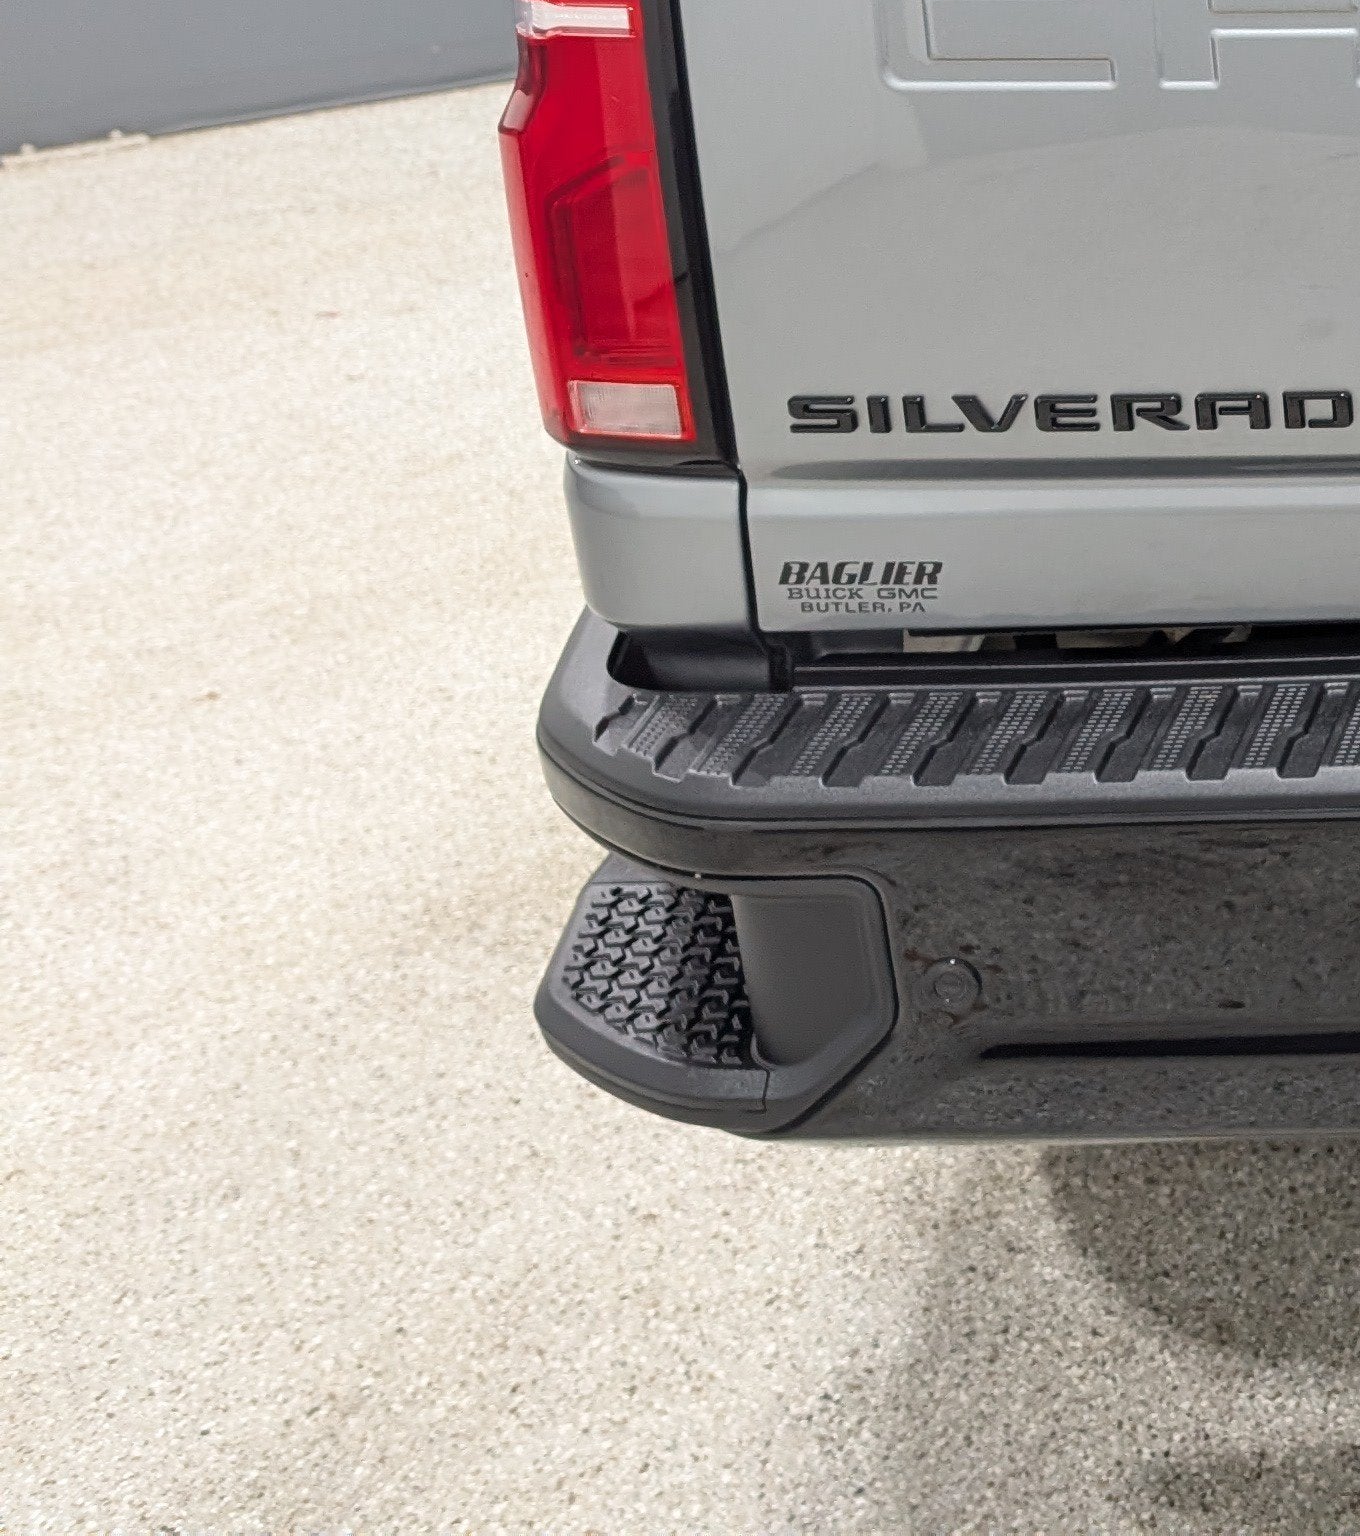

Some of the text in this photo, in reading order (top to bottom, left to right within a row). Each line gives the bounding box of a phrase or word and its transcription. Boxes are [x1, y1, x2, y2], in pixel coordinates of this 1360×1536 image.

[778, 560, 943, 586] BAGLIER
[787, 587, 938, 600] BUICK GMC
[899, 601, 926, 613] PA
